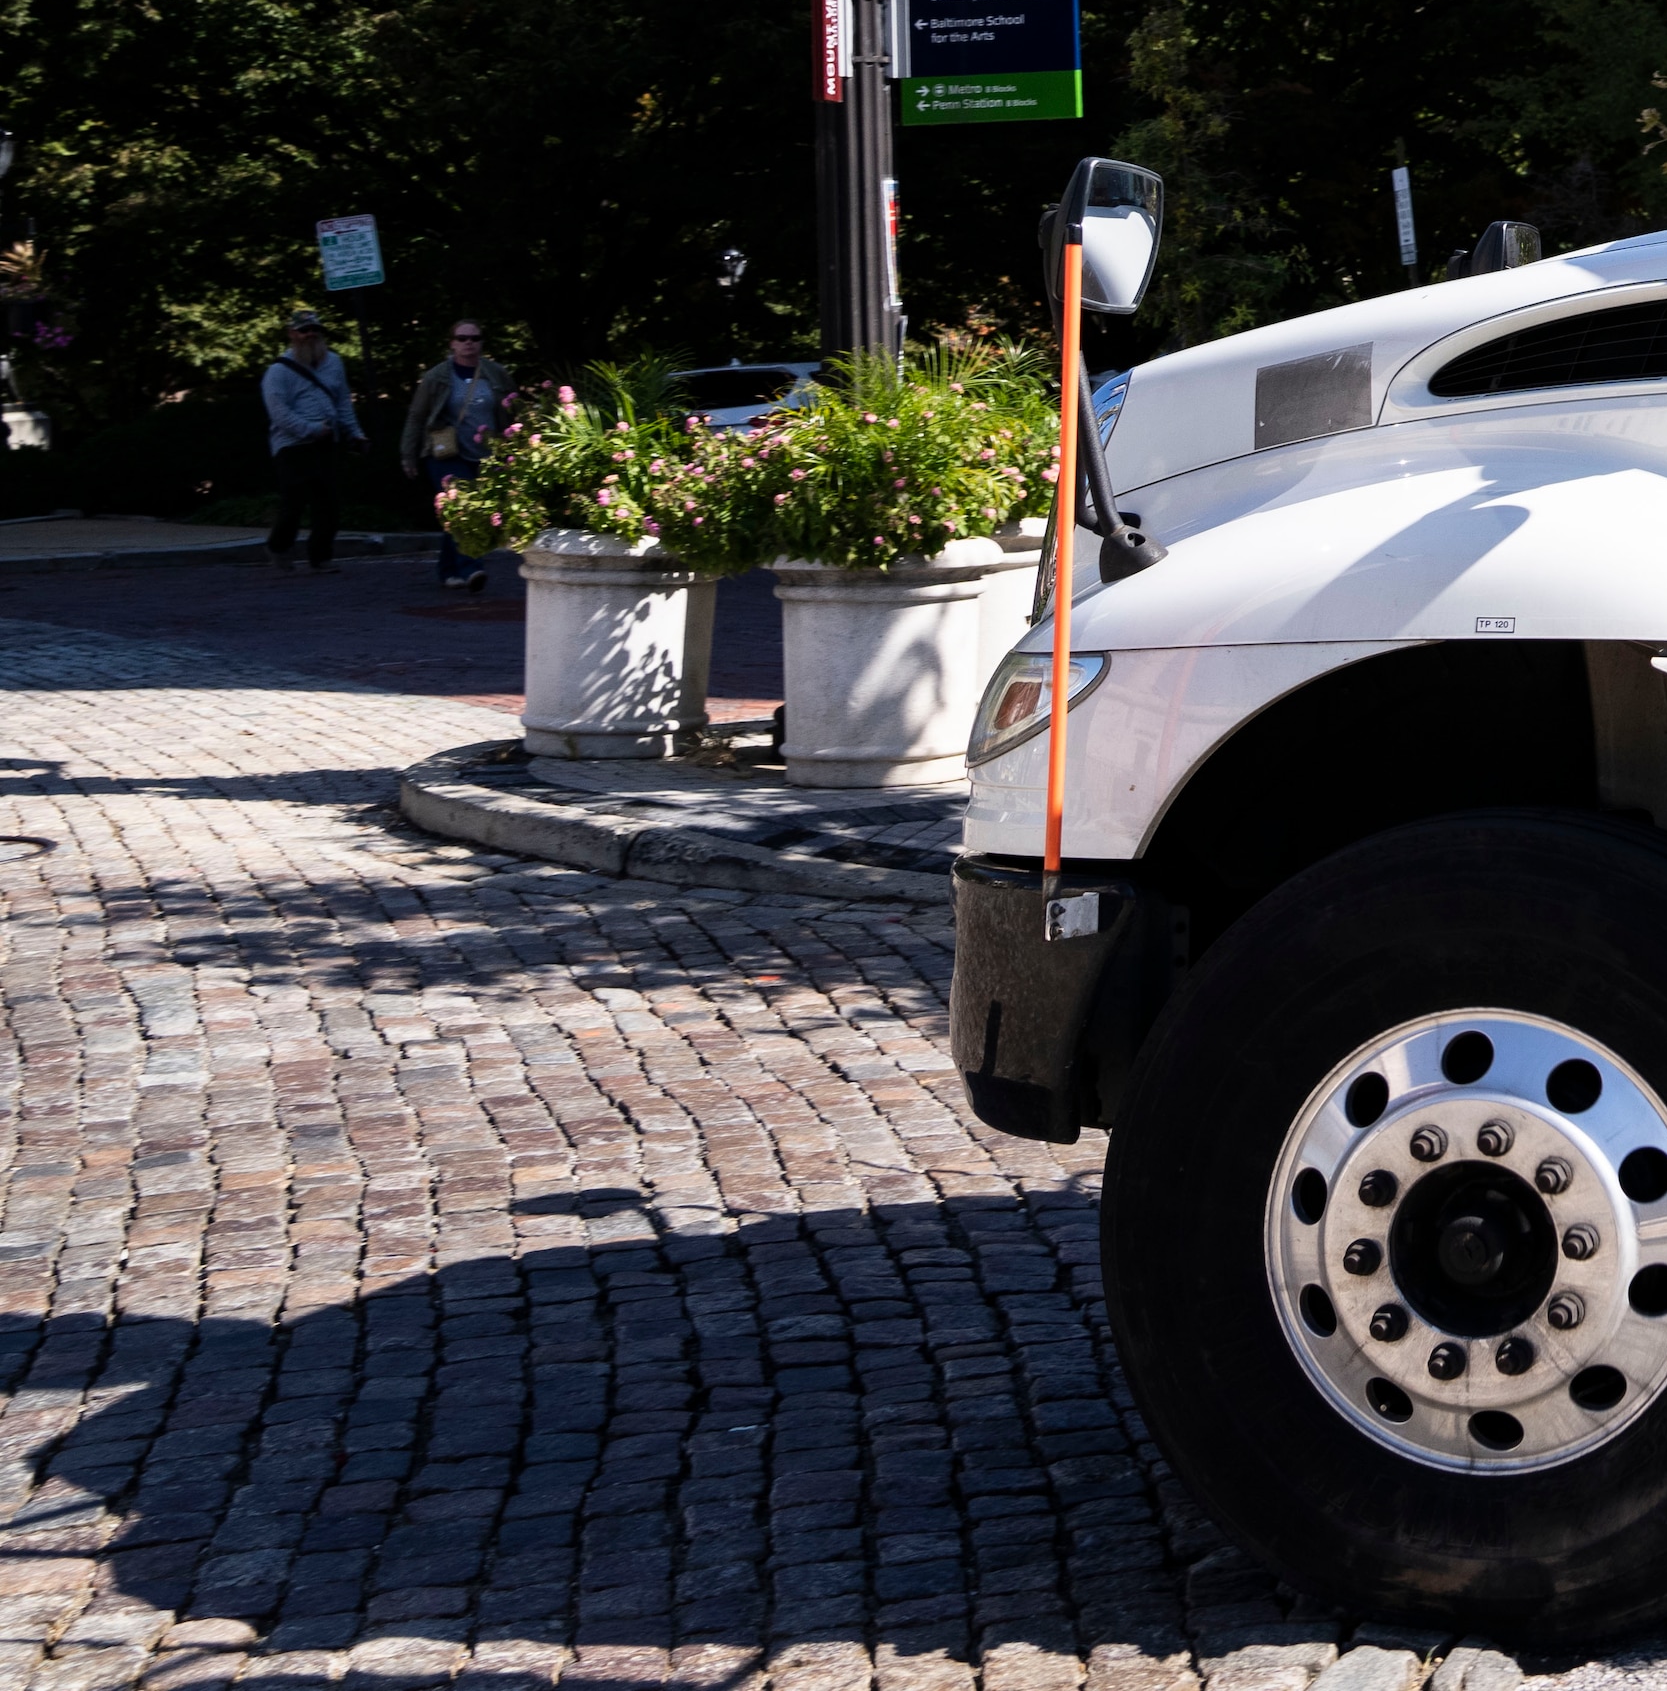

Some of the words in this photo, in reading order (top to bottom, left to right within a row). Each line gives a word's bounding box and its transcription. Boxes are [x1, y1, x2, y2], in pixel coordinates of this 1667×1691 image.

[930, 17, 985, 28] Baltimore
[986, 14, 1025, 26] School
[931, 33, 947, 43] for
[950, 32, 969, 42] the
[970, 31, 995, 41] Arts
[948, 84, 983, 94] Metro
[932, 100, 961, 110] Penn
[962, 97, 1003, 109] Station
[1479, 620, 1491, 628] TP
